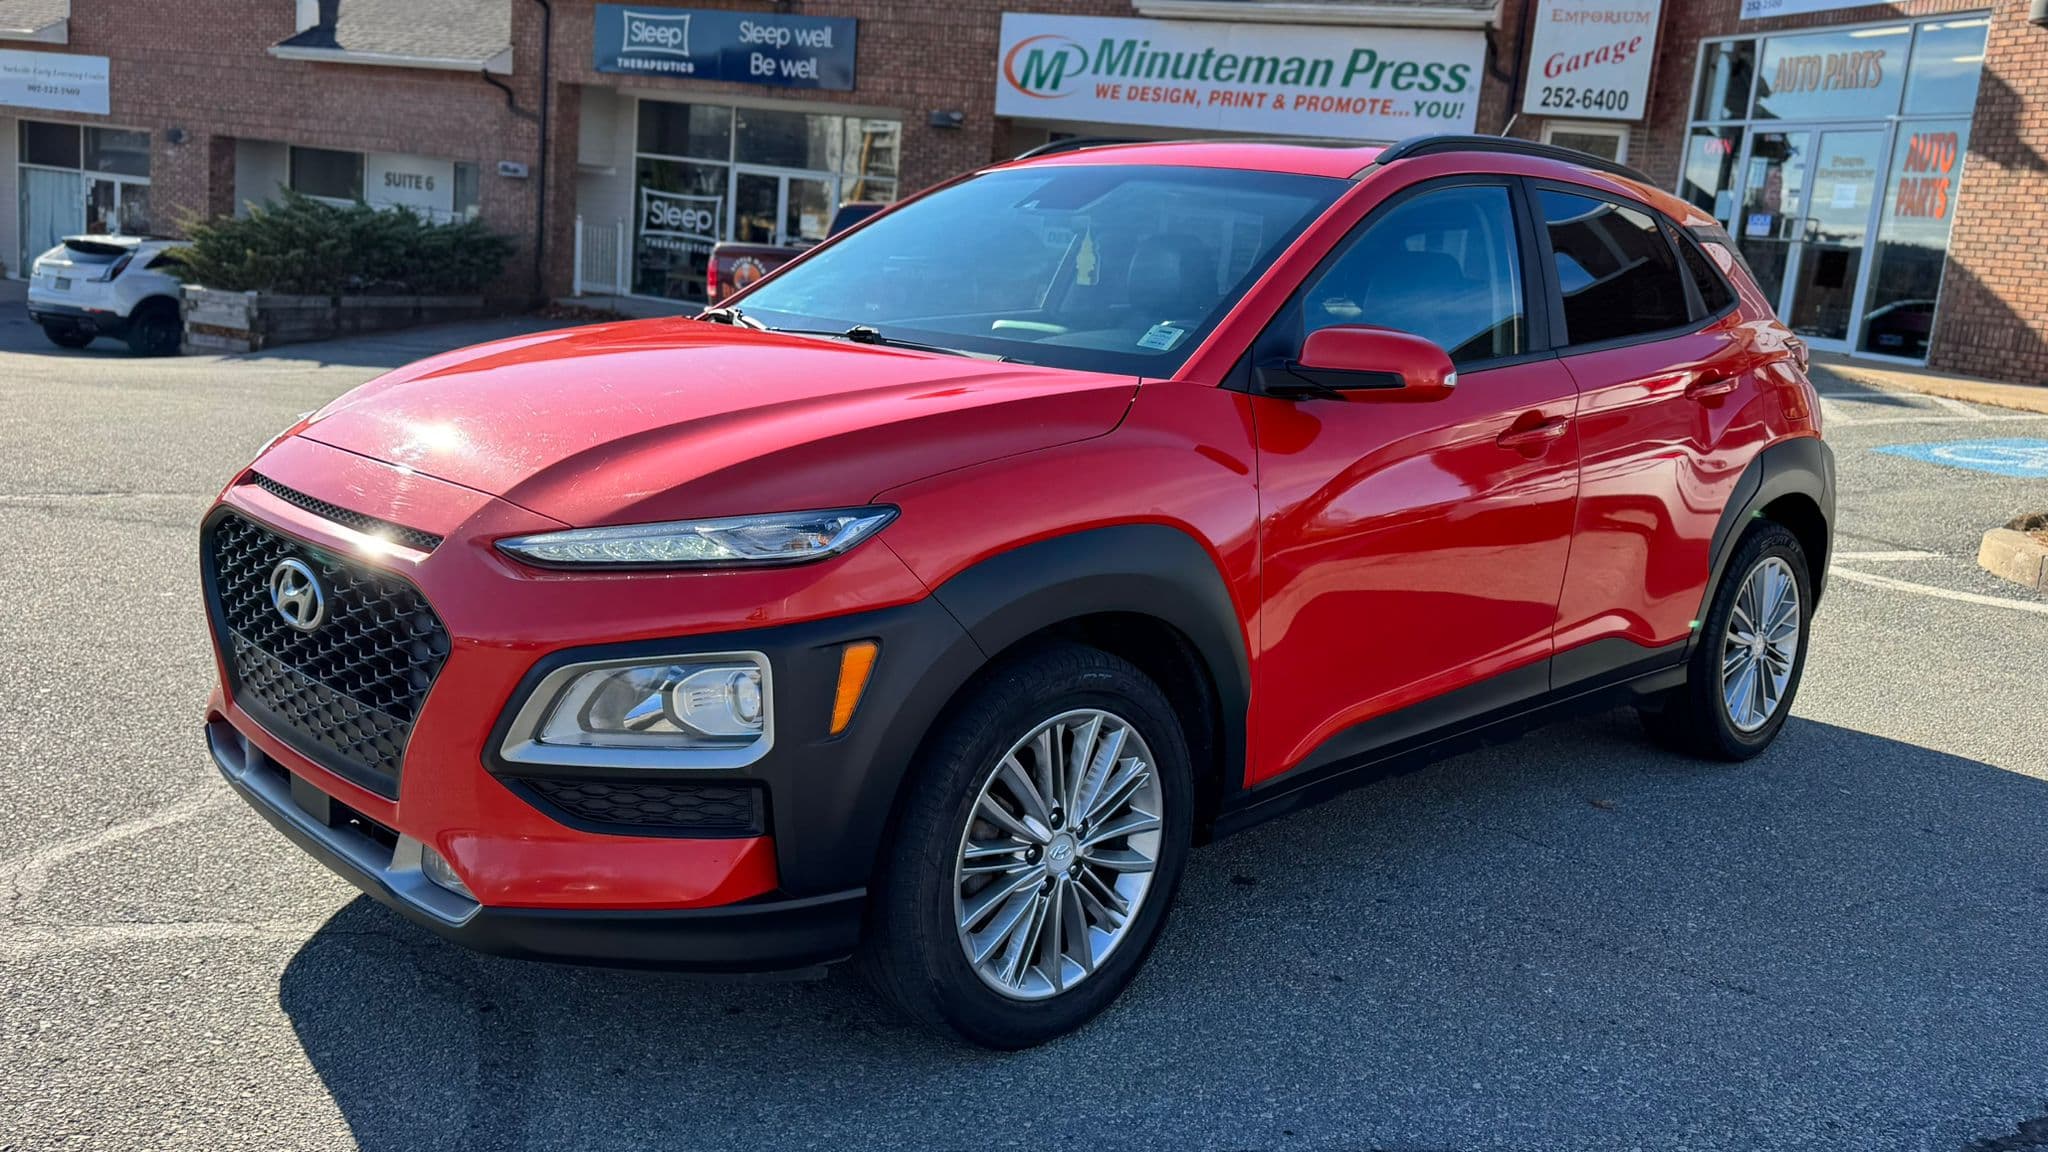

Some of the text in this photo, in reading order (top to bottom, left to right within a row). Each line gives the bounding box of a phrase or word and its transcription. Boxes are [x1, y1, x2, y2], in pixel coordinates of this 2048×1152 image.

[1551, 8, 1652, 24] EMPORIUM
[630, 21, 682, 48] Sleep
[739, 20, 791, 49] Sleep
[617, 57, 695, 73] THERAPEUTICS
[750, 52, 776, 75] Be
[1092, 37, 1471, 94] Minuteman Press
[1543, 35, 1642, 80] Garage
[1773, 49, 1886, 94] AUTO PARTS
[1095, 83, 1121, 100] WE
[1127, 86, 1202, 109] DESIGN,
[1208, 90, 1268, 110] PRINT
[1272, 93, 1285, 110] &
[1413, 101, 1465, 120] YOU!
[1540, 86, 1629, 112] 252-6400
[1903, 131, 1958, 175] AUTO
[384, 171, 435, 191] SUITE 6
[1895, 176, 1951, 220] PARTS
[650, 200, 713, 233] Sleep
